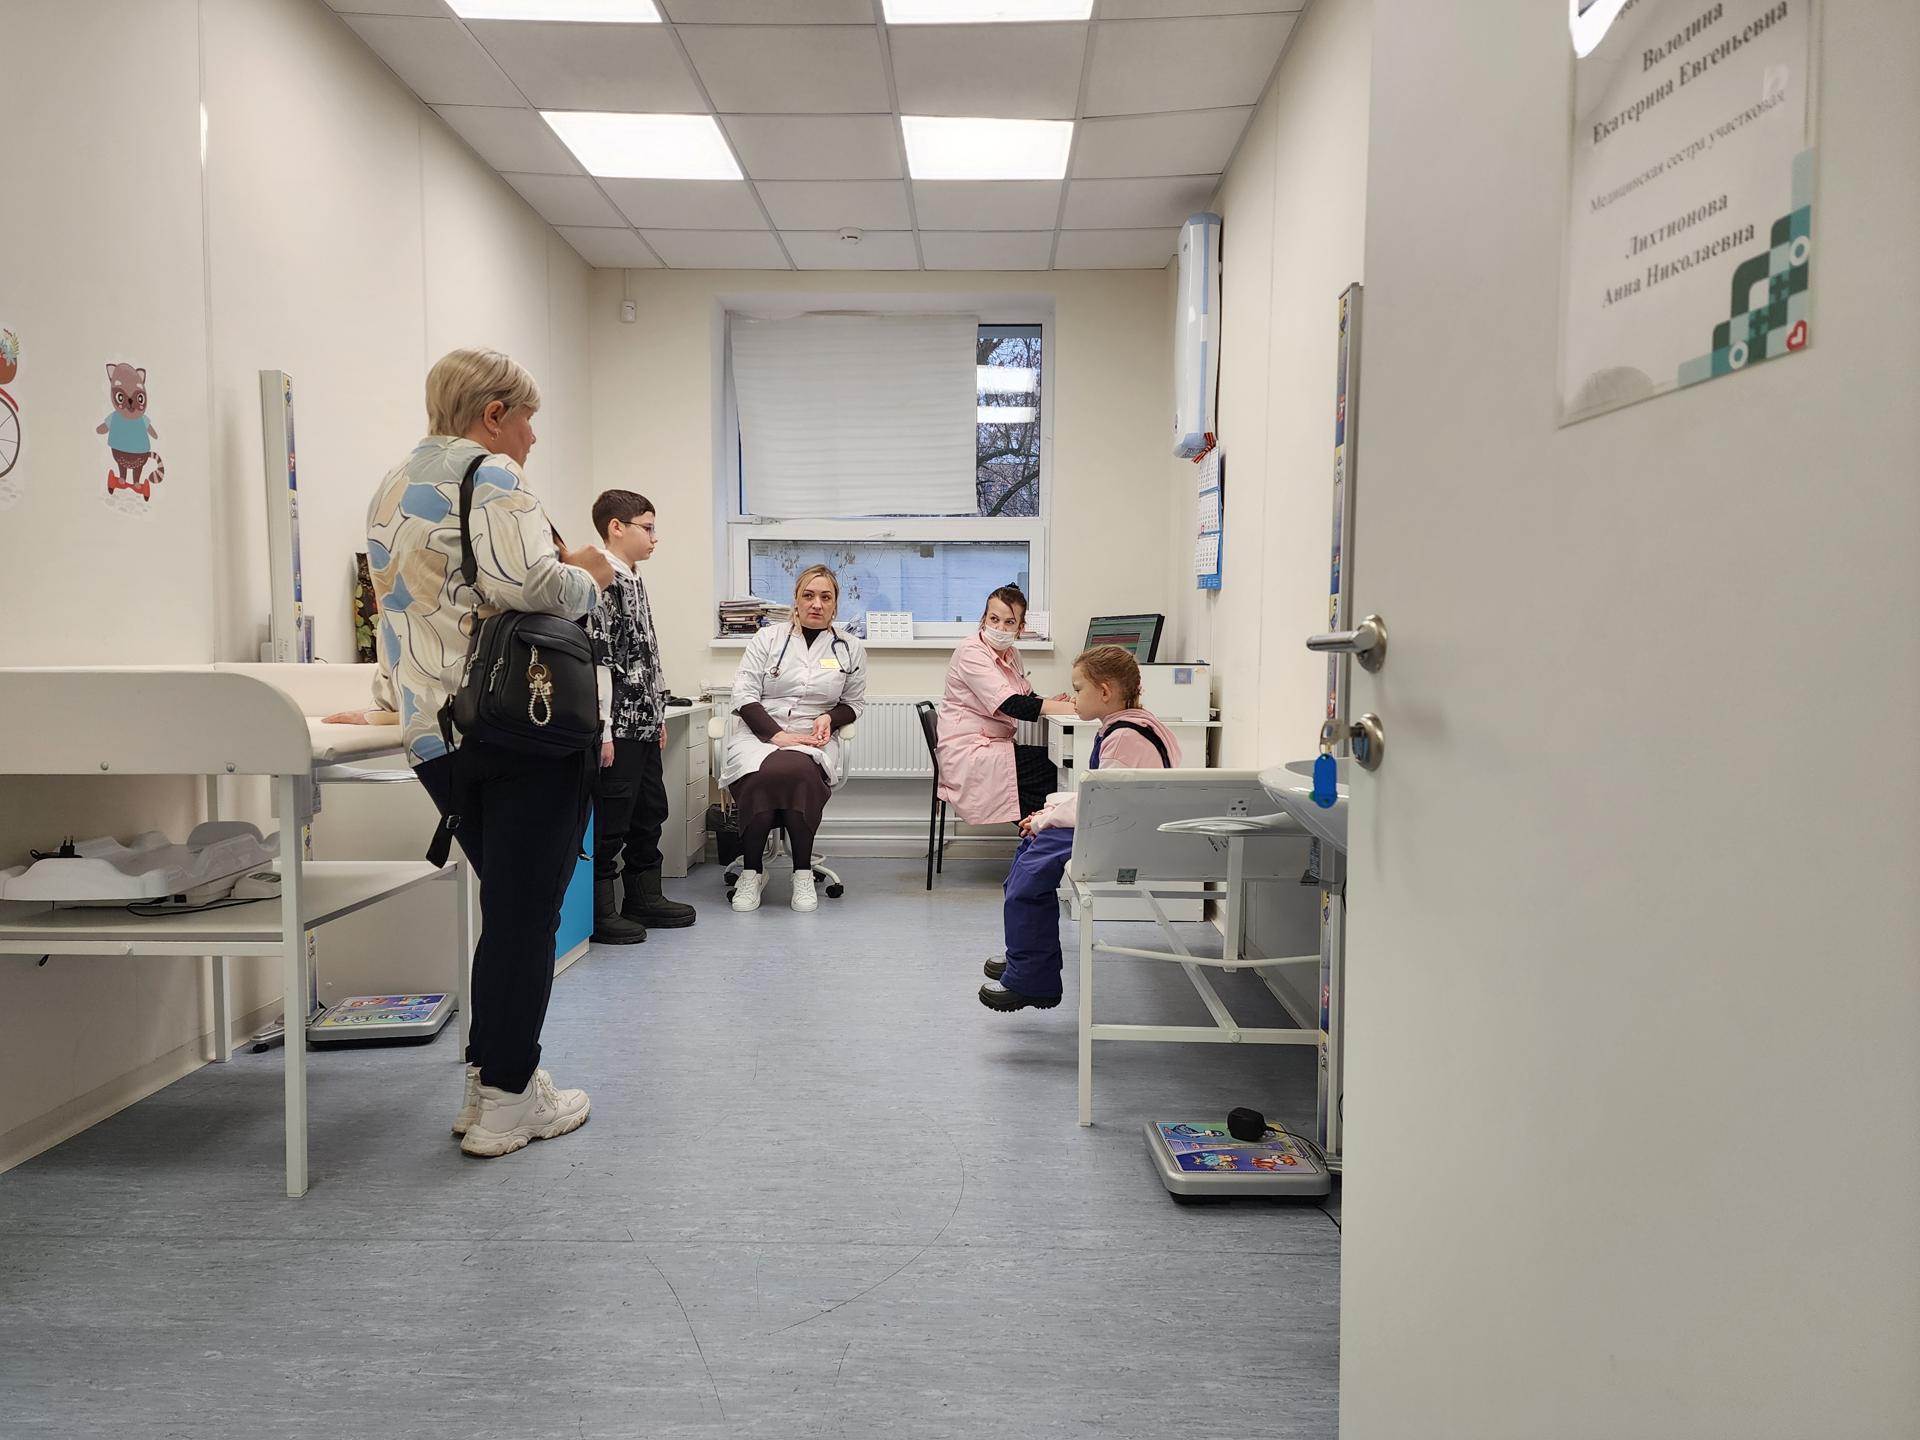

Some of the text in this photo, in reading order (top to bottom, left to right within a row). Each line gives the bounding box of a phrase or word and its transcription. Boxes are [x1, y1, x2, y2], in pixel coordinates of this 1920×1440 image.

[1592, 1, 1789, 145] Екатерина Евгеньевна
[1642, 3, 1724, 72] Володина
[1590, 162, 1665, 213] Медицинская
[1667, 136, 1705, 169] сестра
[1602, 223, 1755, 308] Анна Николаевна
